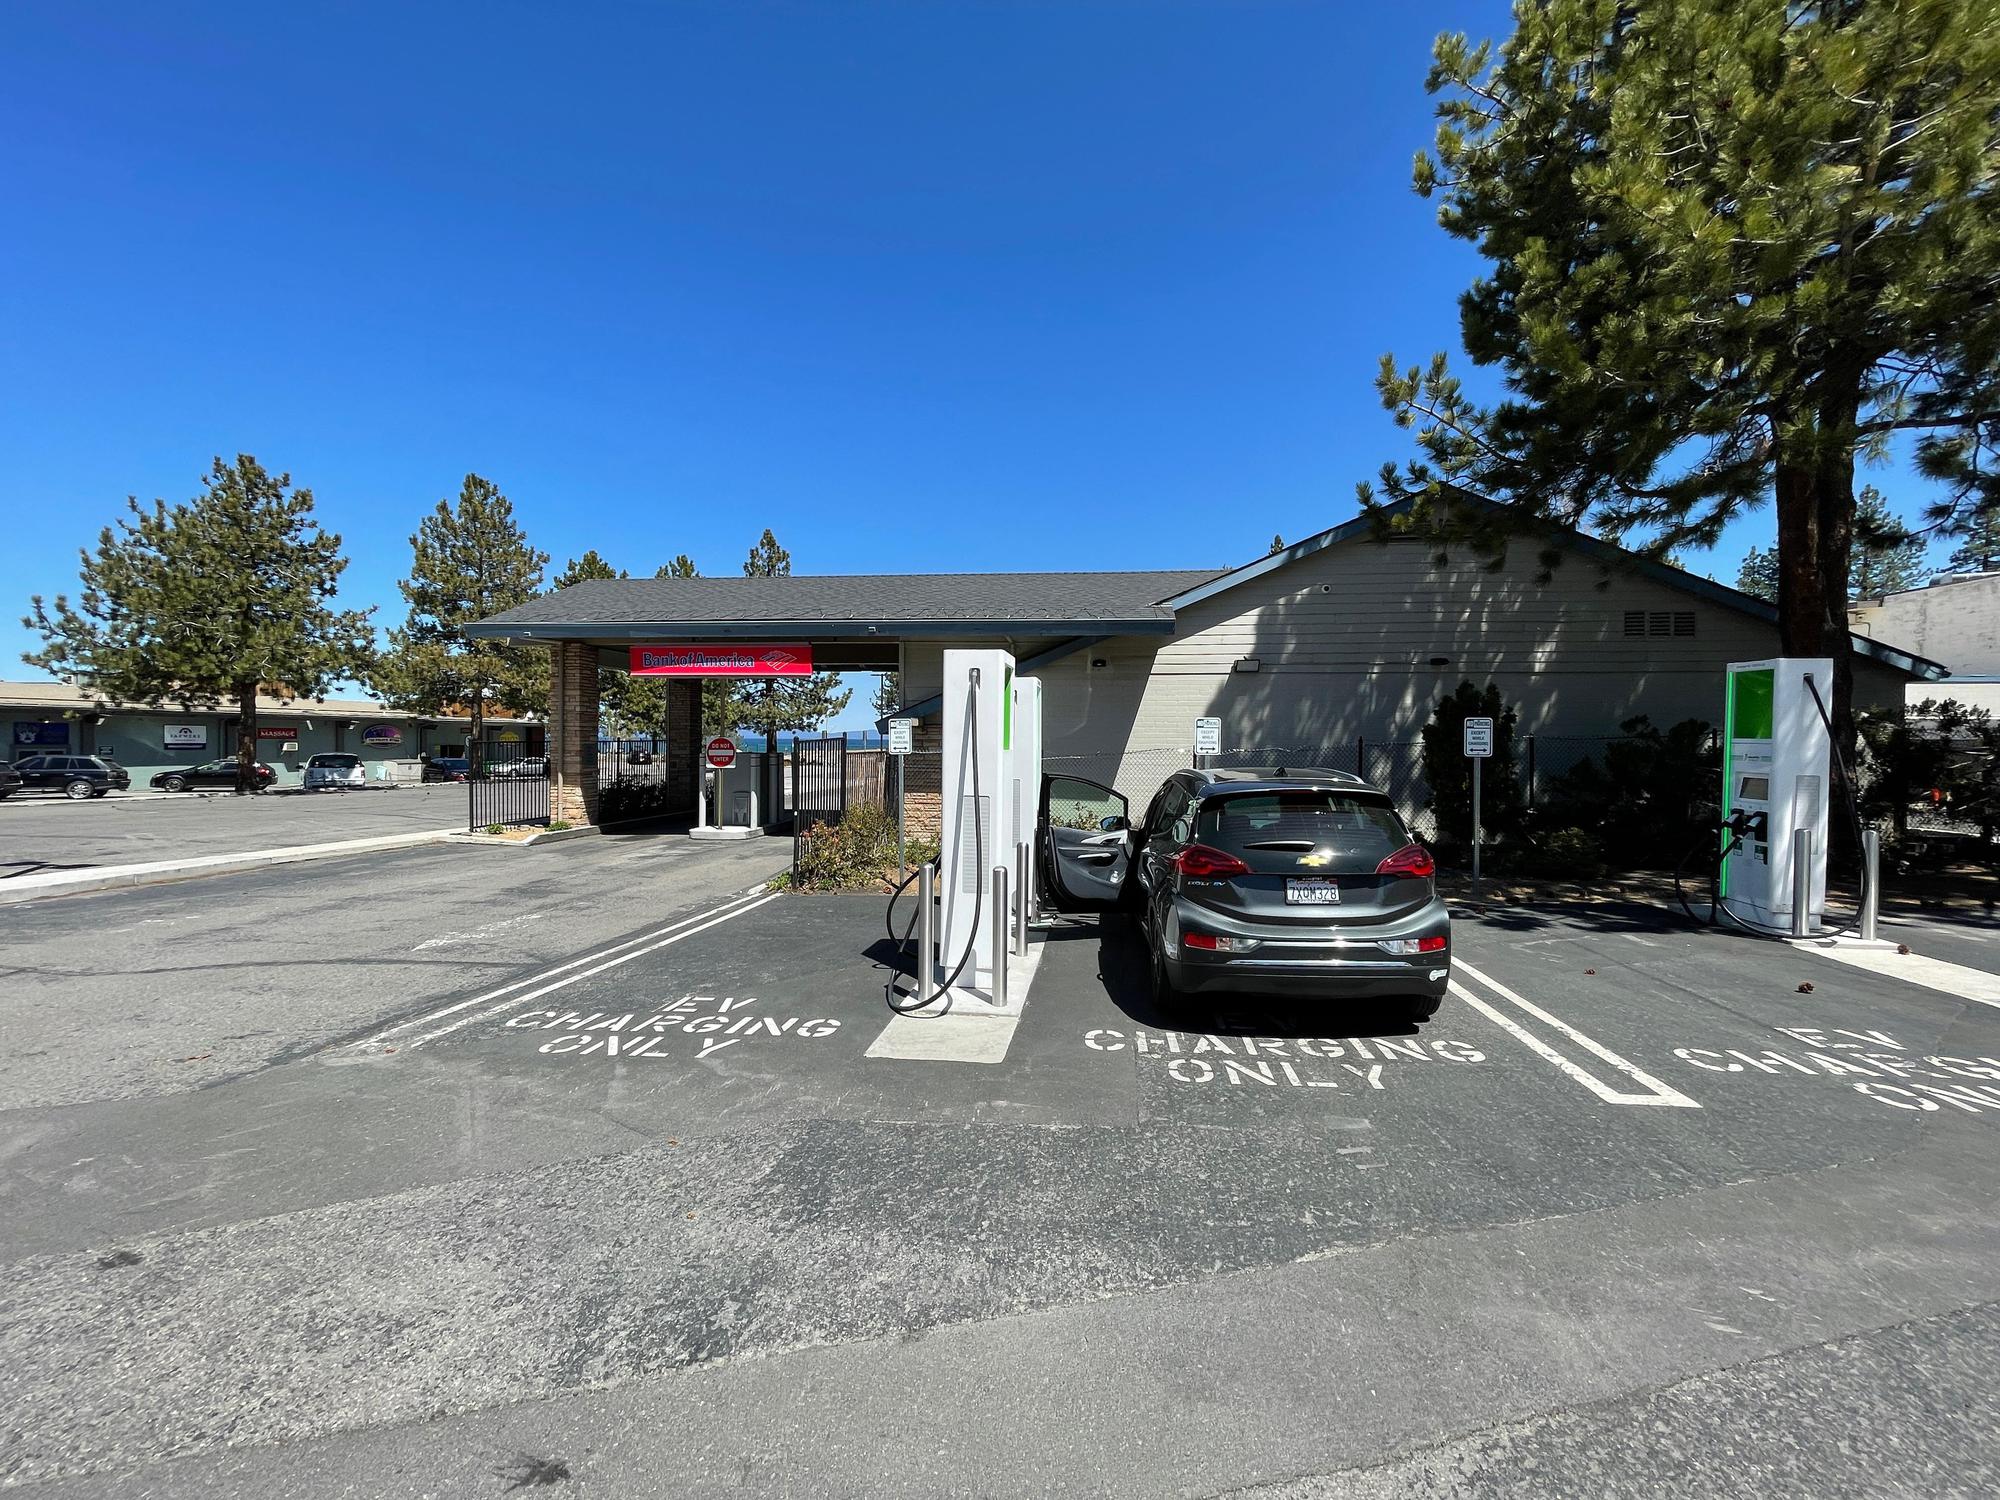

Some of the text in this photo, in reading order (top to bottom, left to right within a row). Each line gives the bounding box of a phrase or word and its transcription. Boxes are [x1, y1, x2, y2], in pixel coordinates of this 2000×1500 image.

[642, 652, 755, 668] Bank of America
[662, 996, 757, 1013] EV
[504, 1010, 842, 1038] CHARGING
[538, 1033, 741, 1059] ONLY
[1084, 1029, 1487, 1063] CHARGING
[1774, 1027, 1908, 1051] EV
[1167, 1058, 1386, 1090] ONLY
